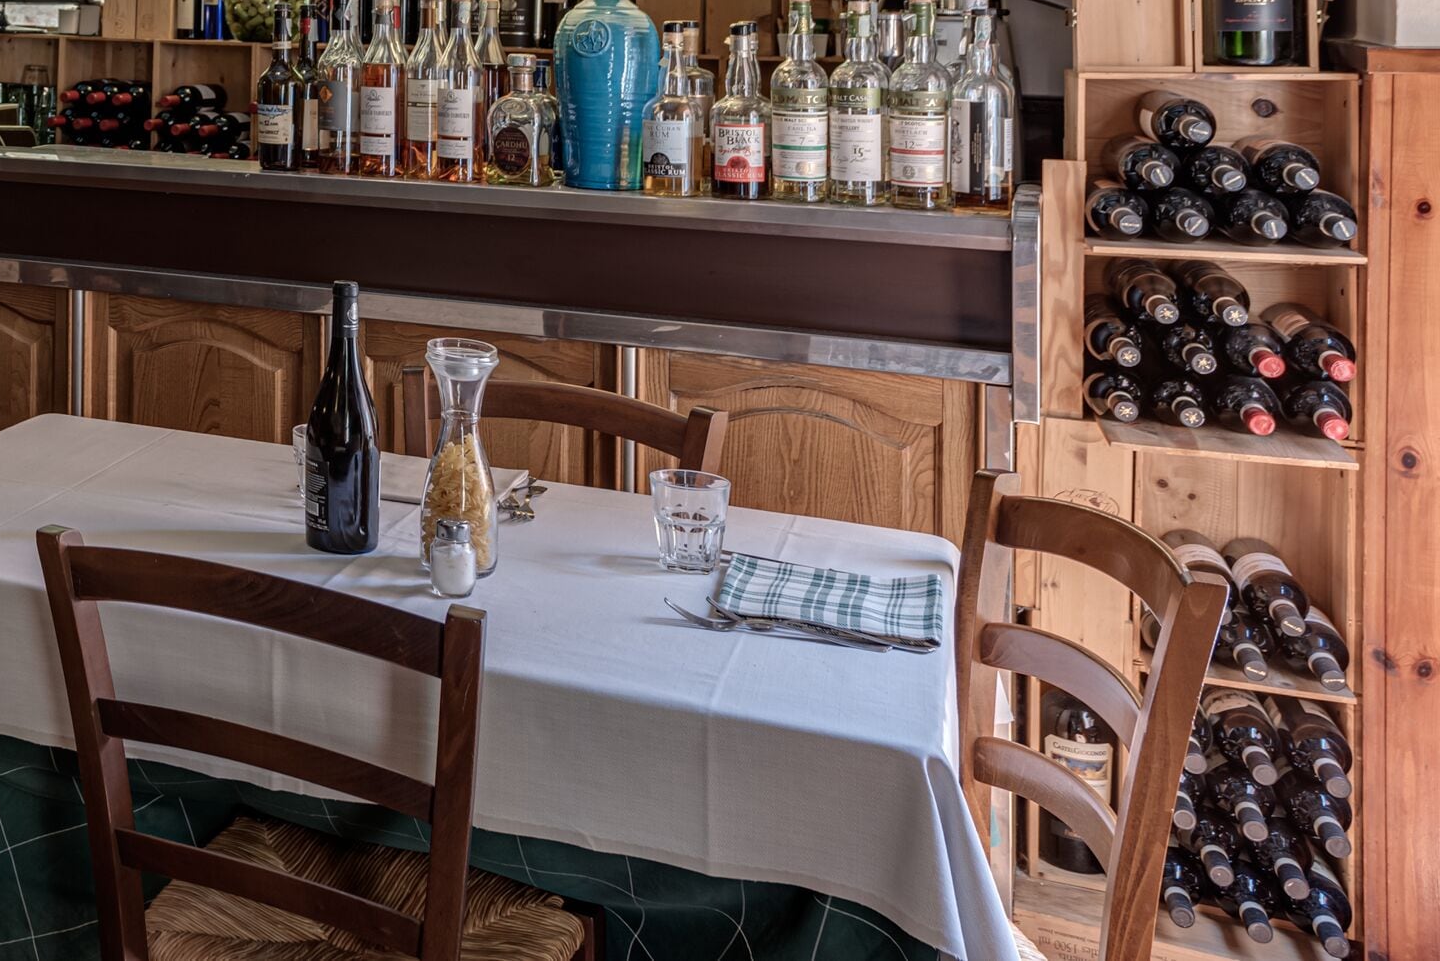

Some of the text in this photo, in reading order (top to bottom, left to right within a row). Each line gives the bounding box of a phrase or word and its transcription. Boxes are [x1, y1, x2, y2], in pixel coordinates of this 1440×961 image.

[495, 139, 528, 150] CARDHU
[904, 140, 917, 150] 12
[1053, 939, 1078, 955] 1500
